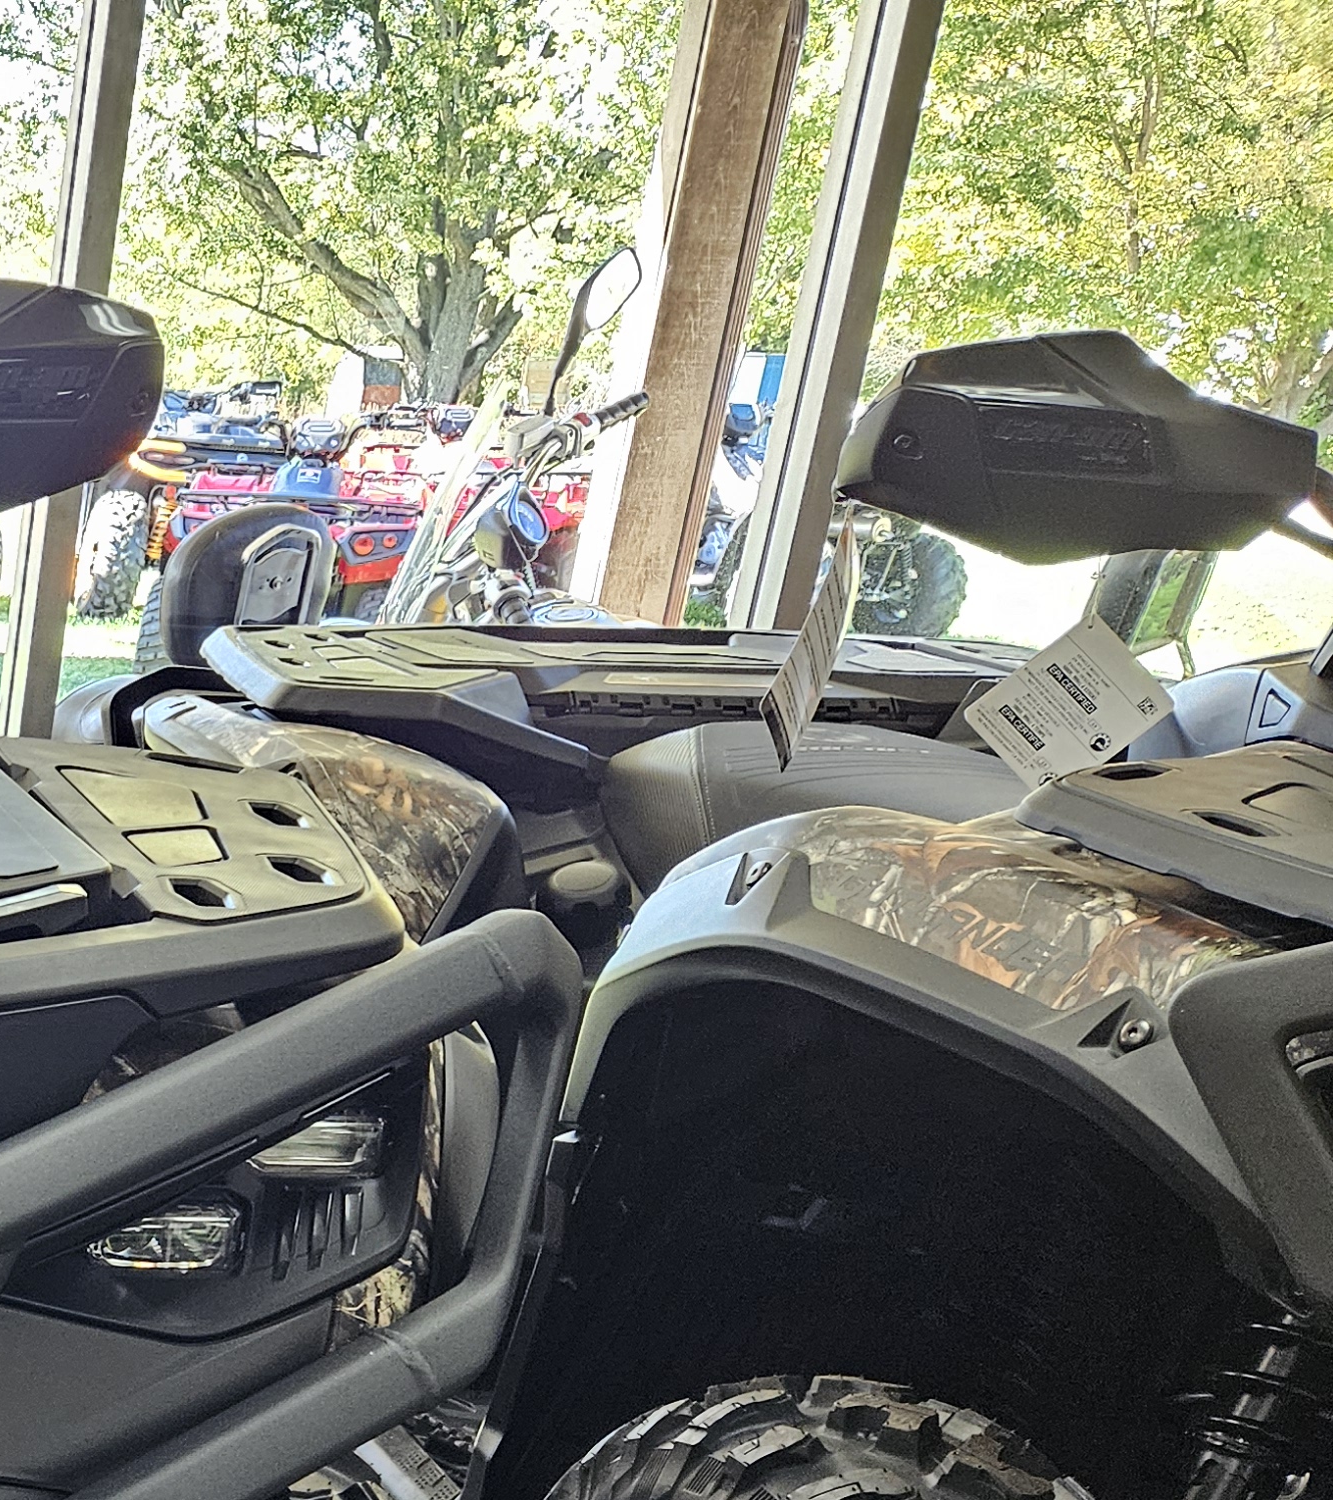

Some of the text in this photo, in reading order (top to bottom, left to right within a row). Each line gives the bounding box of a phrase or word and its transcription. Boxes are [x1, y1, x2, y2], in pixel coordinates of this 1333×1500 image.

[1049, 666, 1064, 682] EPA
[1060, 678, 1096, 713] CERTIFIED
[1001, 707, 1016, 722] EPA
